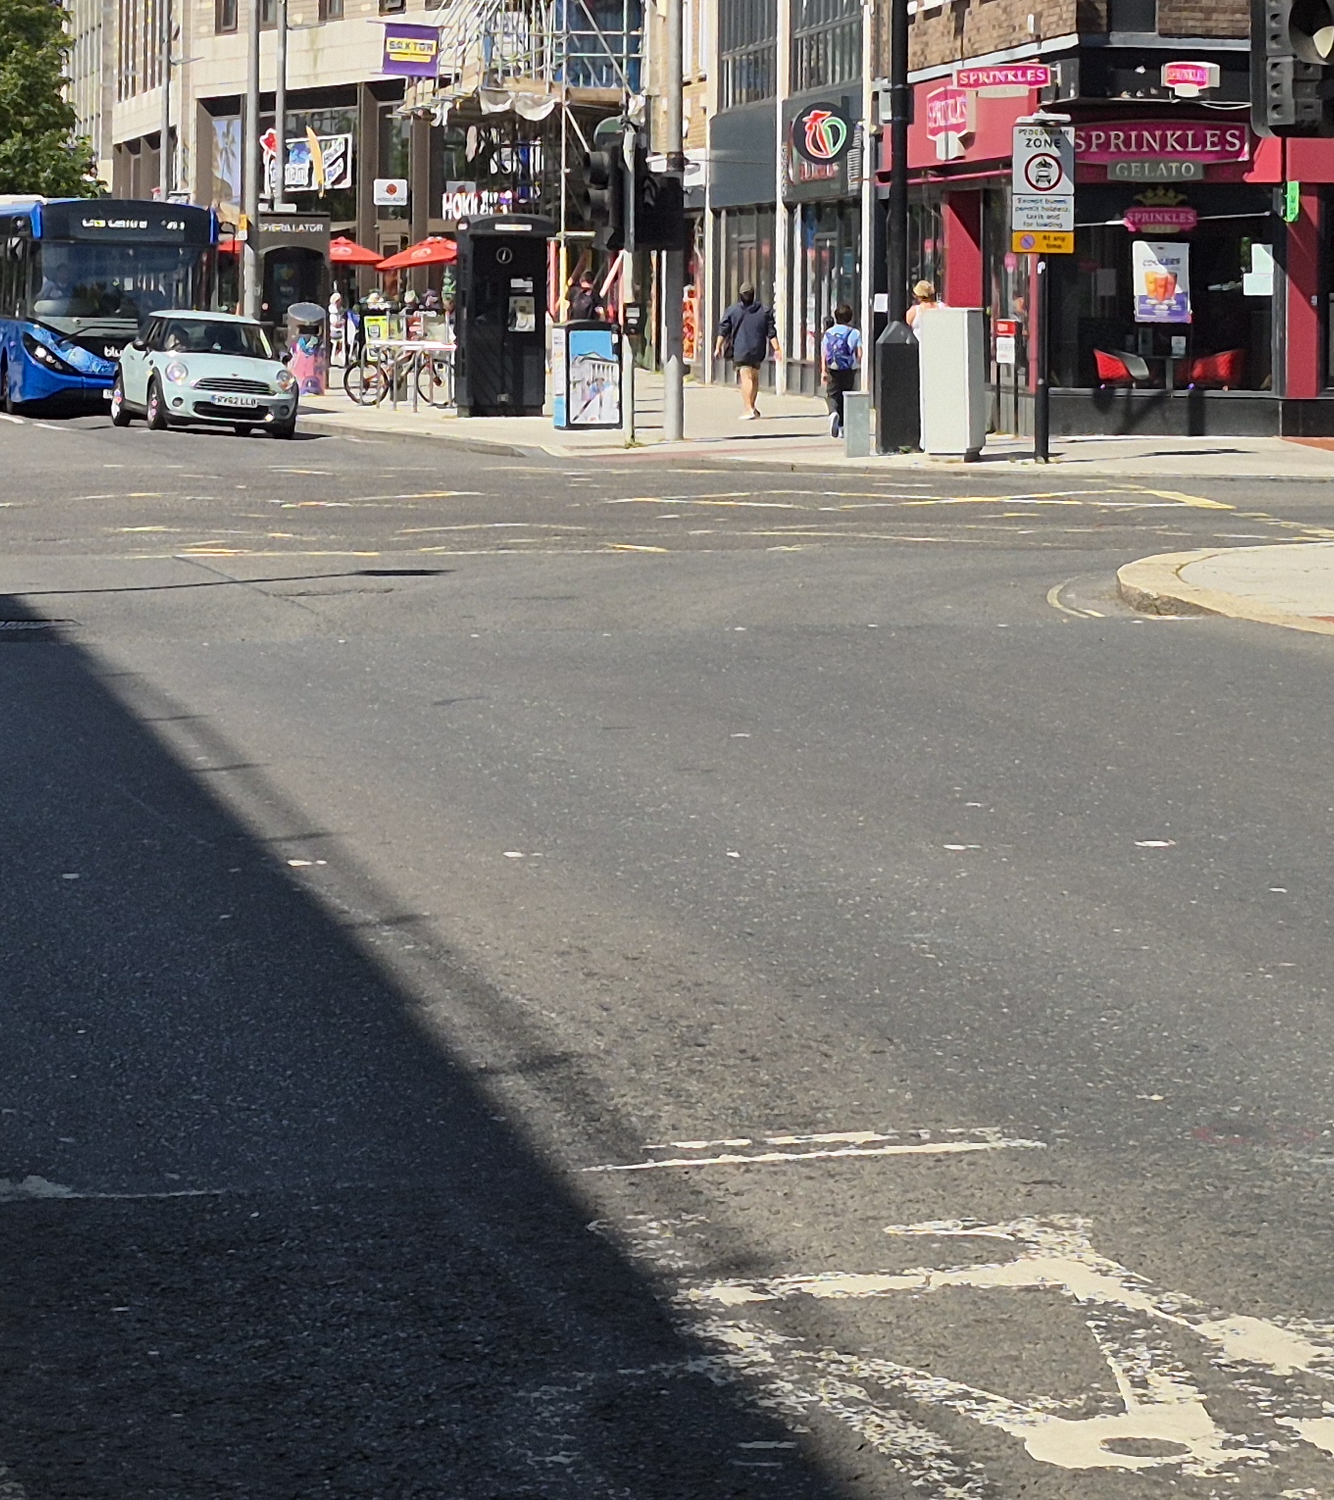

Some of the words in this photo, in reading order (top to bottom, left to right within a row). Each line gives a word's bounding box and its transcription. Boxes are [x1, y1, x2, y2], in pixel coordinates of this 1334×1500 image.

[959, 69, 1046, 84] SPRINKLES
[1025, 138, 1062, 149] ZONE
[1075, 129, 1241, 152] SPRINKLES
[1116, 162, 1195, 177] GELATO
[1127, 212, 1195, 223] SPRINKLES
